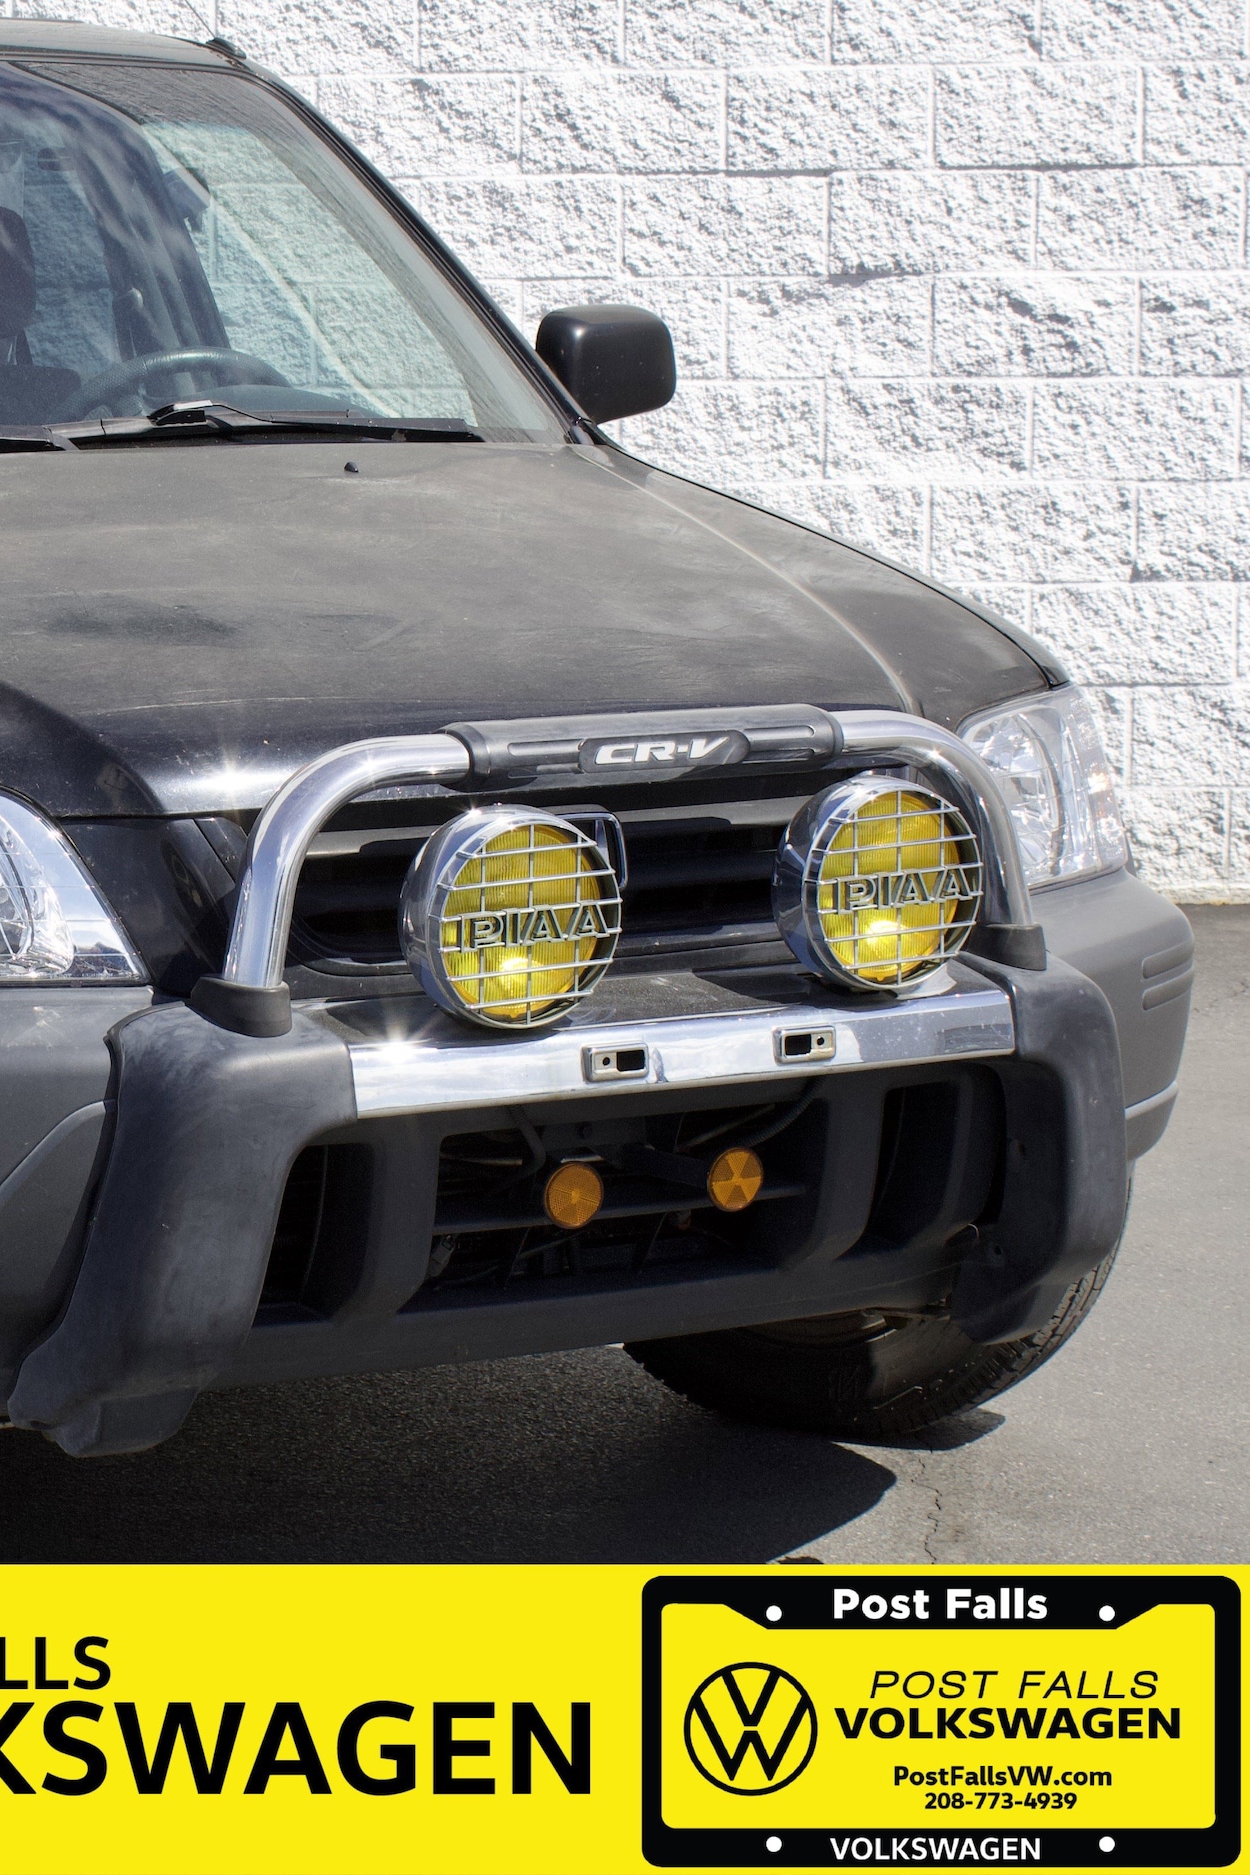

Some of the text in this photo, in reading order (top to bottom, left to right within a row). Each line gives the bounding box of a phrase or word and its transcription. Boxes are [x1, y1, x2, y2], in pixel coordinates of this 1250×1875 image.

[595, 736, 730, 765] CR-V
[833, 865, 973, 915] PIAA
[457, 901, 610, 953] PIAA
